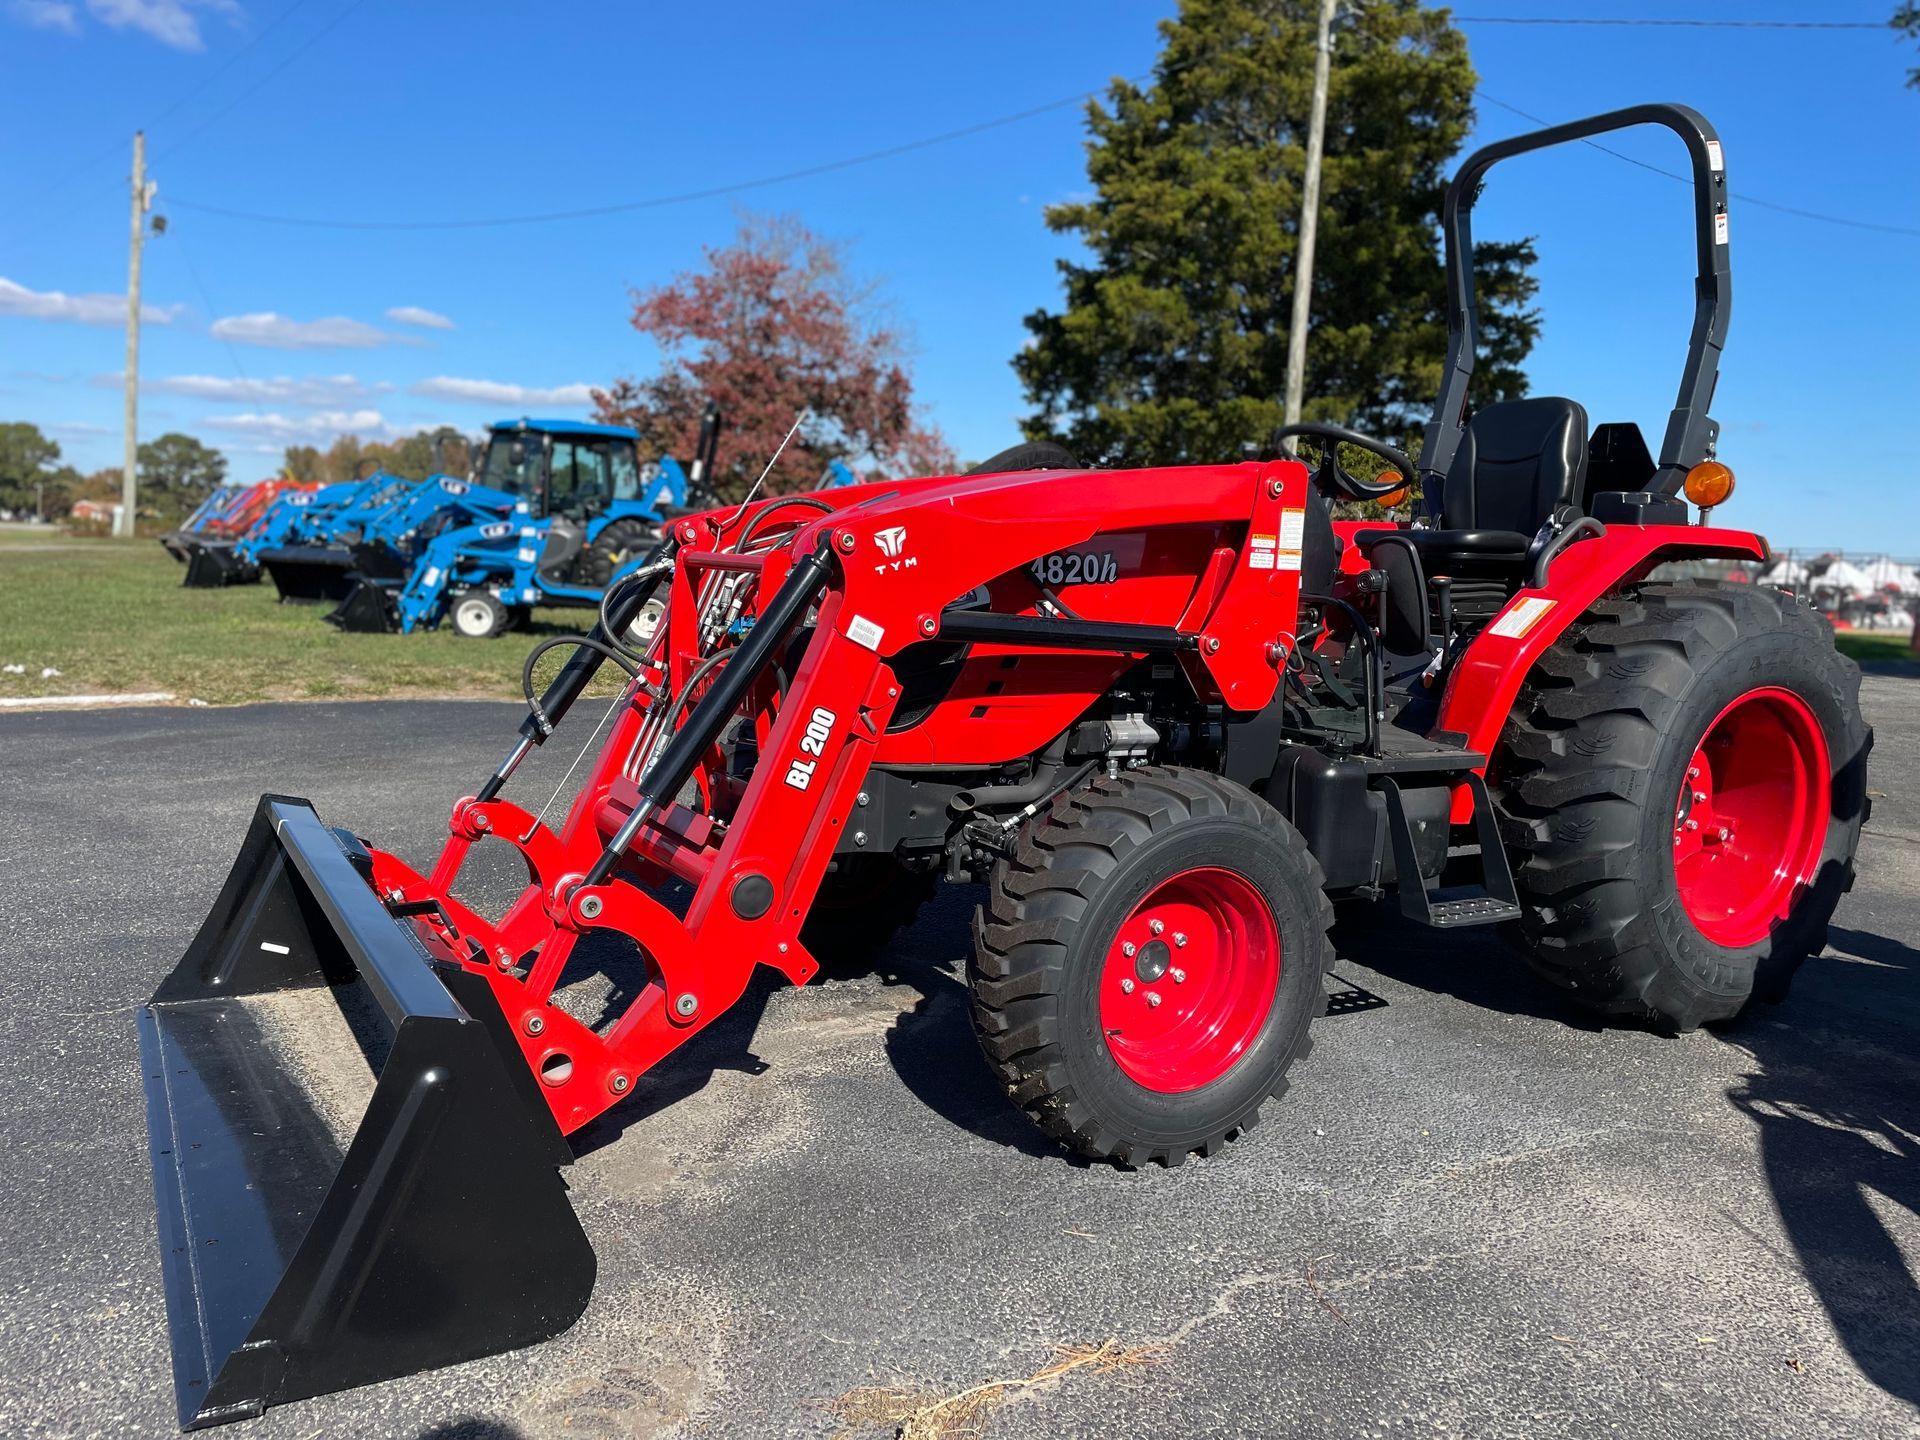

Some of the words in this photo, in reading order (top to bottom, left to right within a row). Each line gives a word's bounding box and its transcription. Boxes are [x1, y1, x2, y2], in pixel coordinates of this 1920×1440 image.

[874, 556, 918, 575] TYM
[1030, 553, 1118, 584] 4820h
[800, 706, 837, 758] 200
[784, 758, 818, 792] BL
